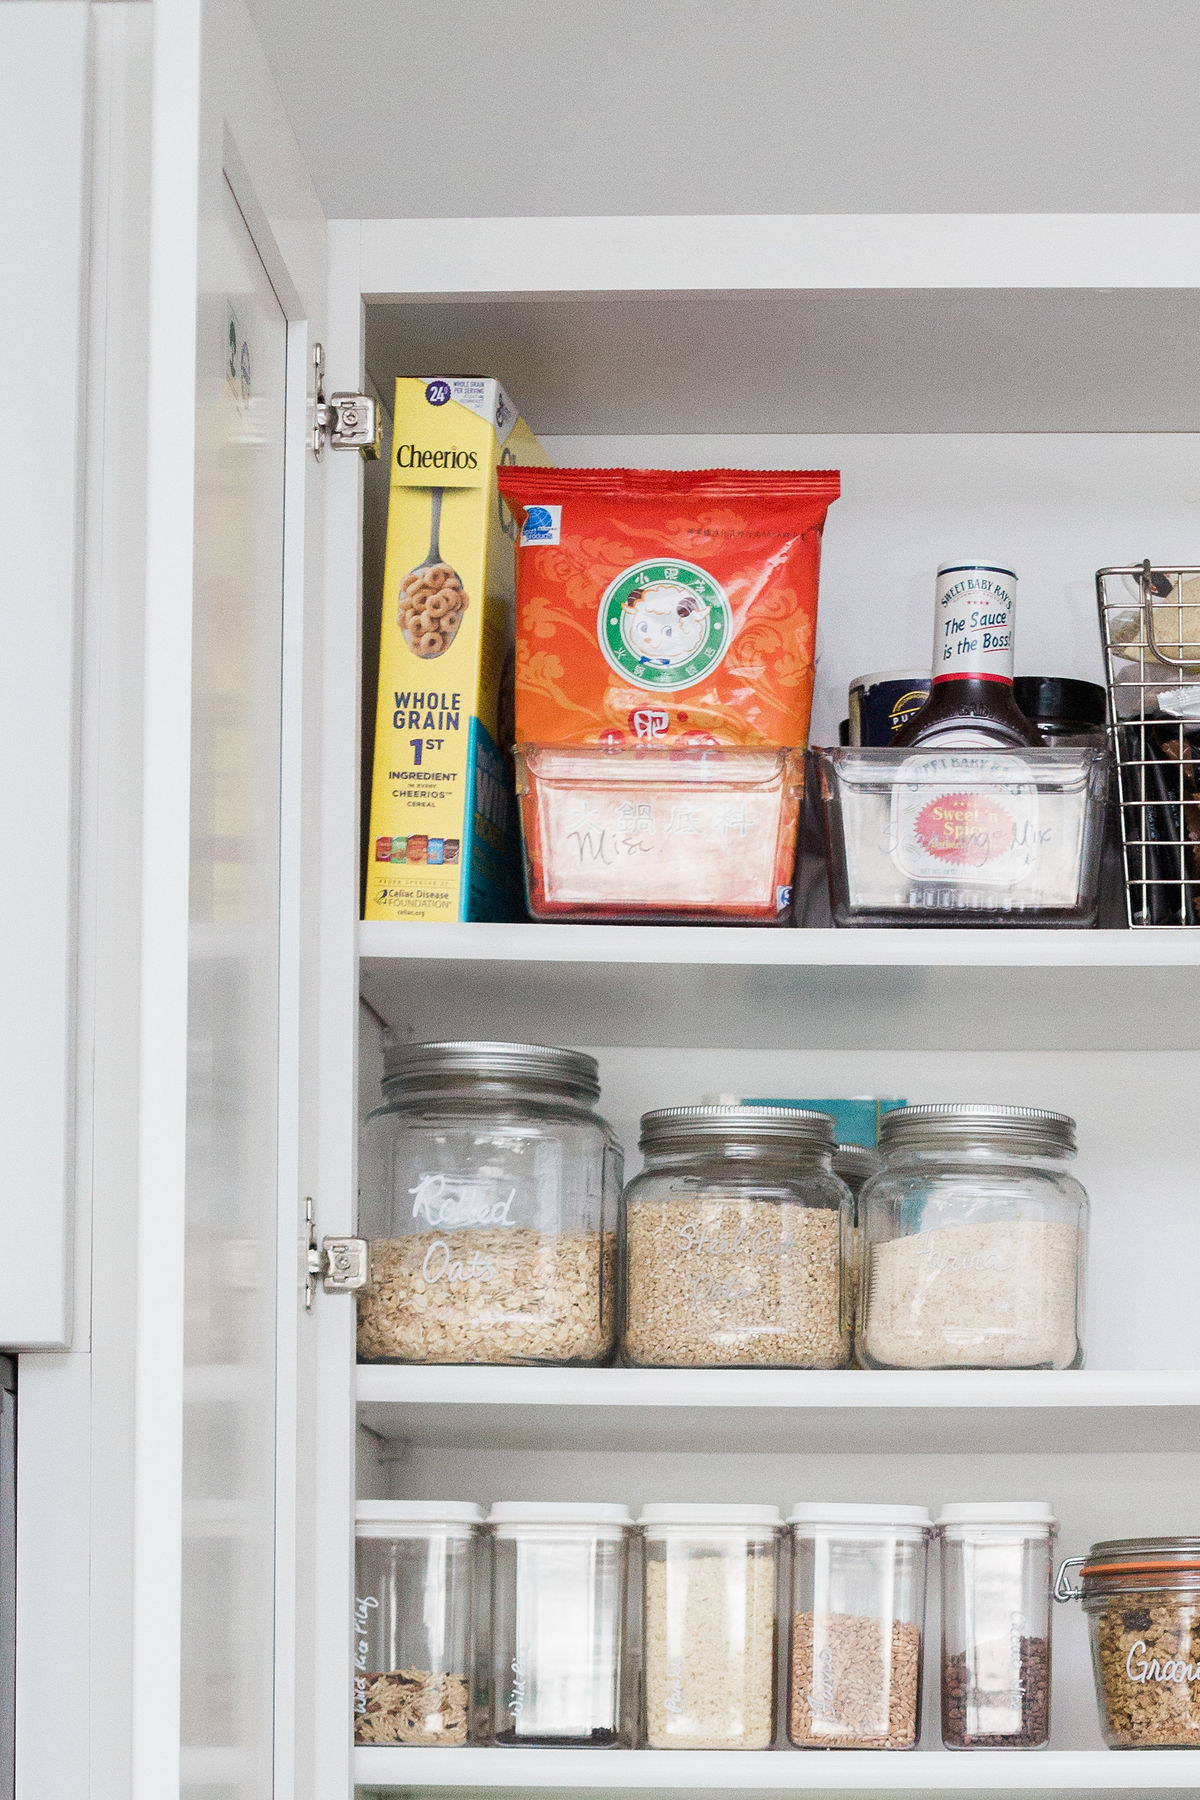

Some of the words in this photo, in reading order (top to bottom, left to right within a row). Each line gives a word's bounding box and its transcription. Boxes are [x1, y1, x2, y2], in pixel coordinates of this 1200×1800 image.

[396, 444, 480, 469] Cheerios
[941, 581, 966, 608] SWEET
[967, 579, 993, 592] BABY
[944, 619, 966, 637] The
[970, 611, 1007, 628] Sauce
[943, 644, 953, 660] is
[956, 637, 978, 656] the
[983, 630, 1012, 650] Boss!
[394, 692, 460, 710] WHOLE
[393, 711, 460, 730] GRAIN
[388, 771, 458, 781] INGREDIENT
[932, 806, 979, 822] Sweet
[416, 889, 449, 900] Disease
[422, 1240, 496, 1285] Oats
